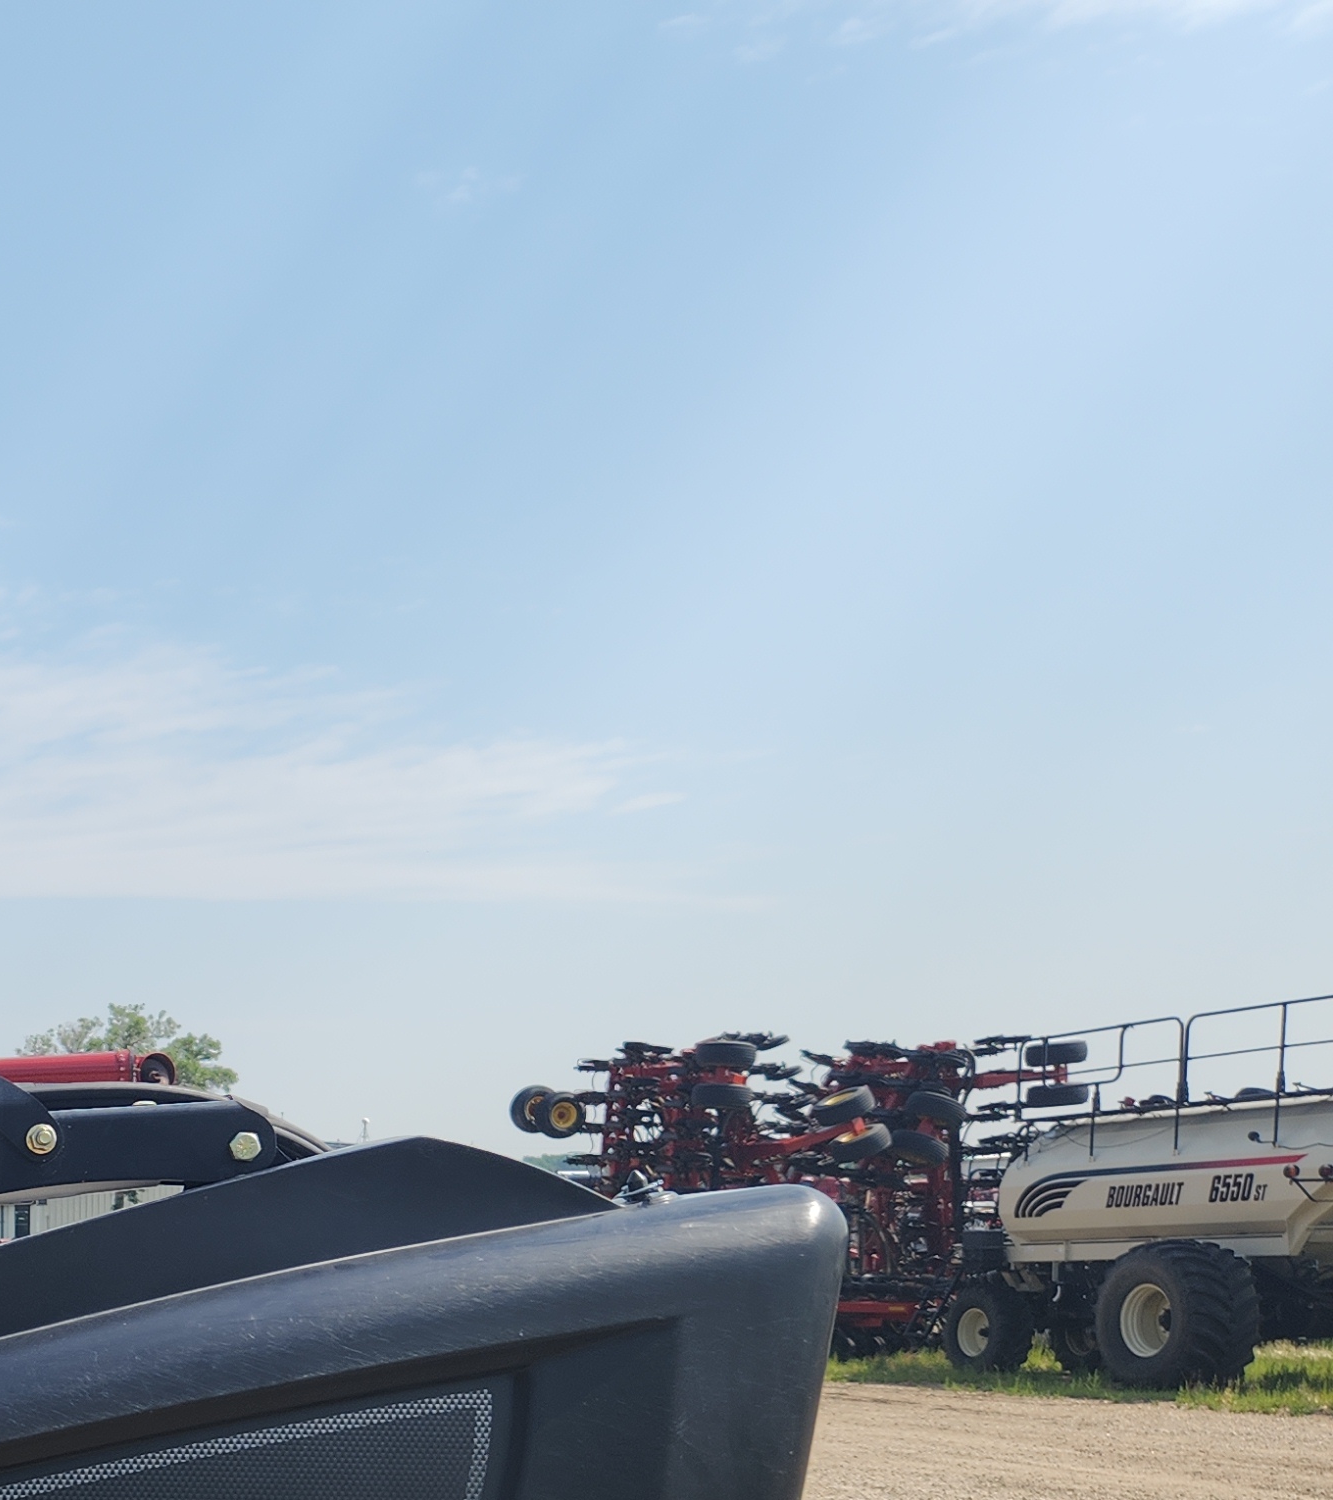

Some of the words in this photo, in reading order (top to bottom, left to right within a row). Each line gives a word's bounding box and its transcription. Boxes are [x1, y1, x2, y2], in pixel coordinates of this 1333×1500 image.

[1105, 1181, 1185, 1209] BOURGAULT
[1208, 1172, 1255, 1204] 6550
[1253, 1183, 1269, 1202] ST
